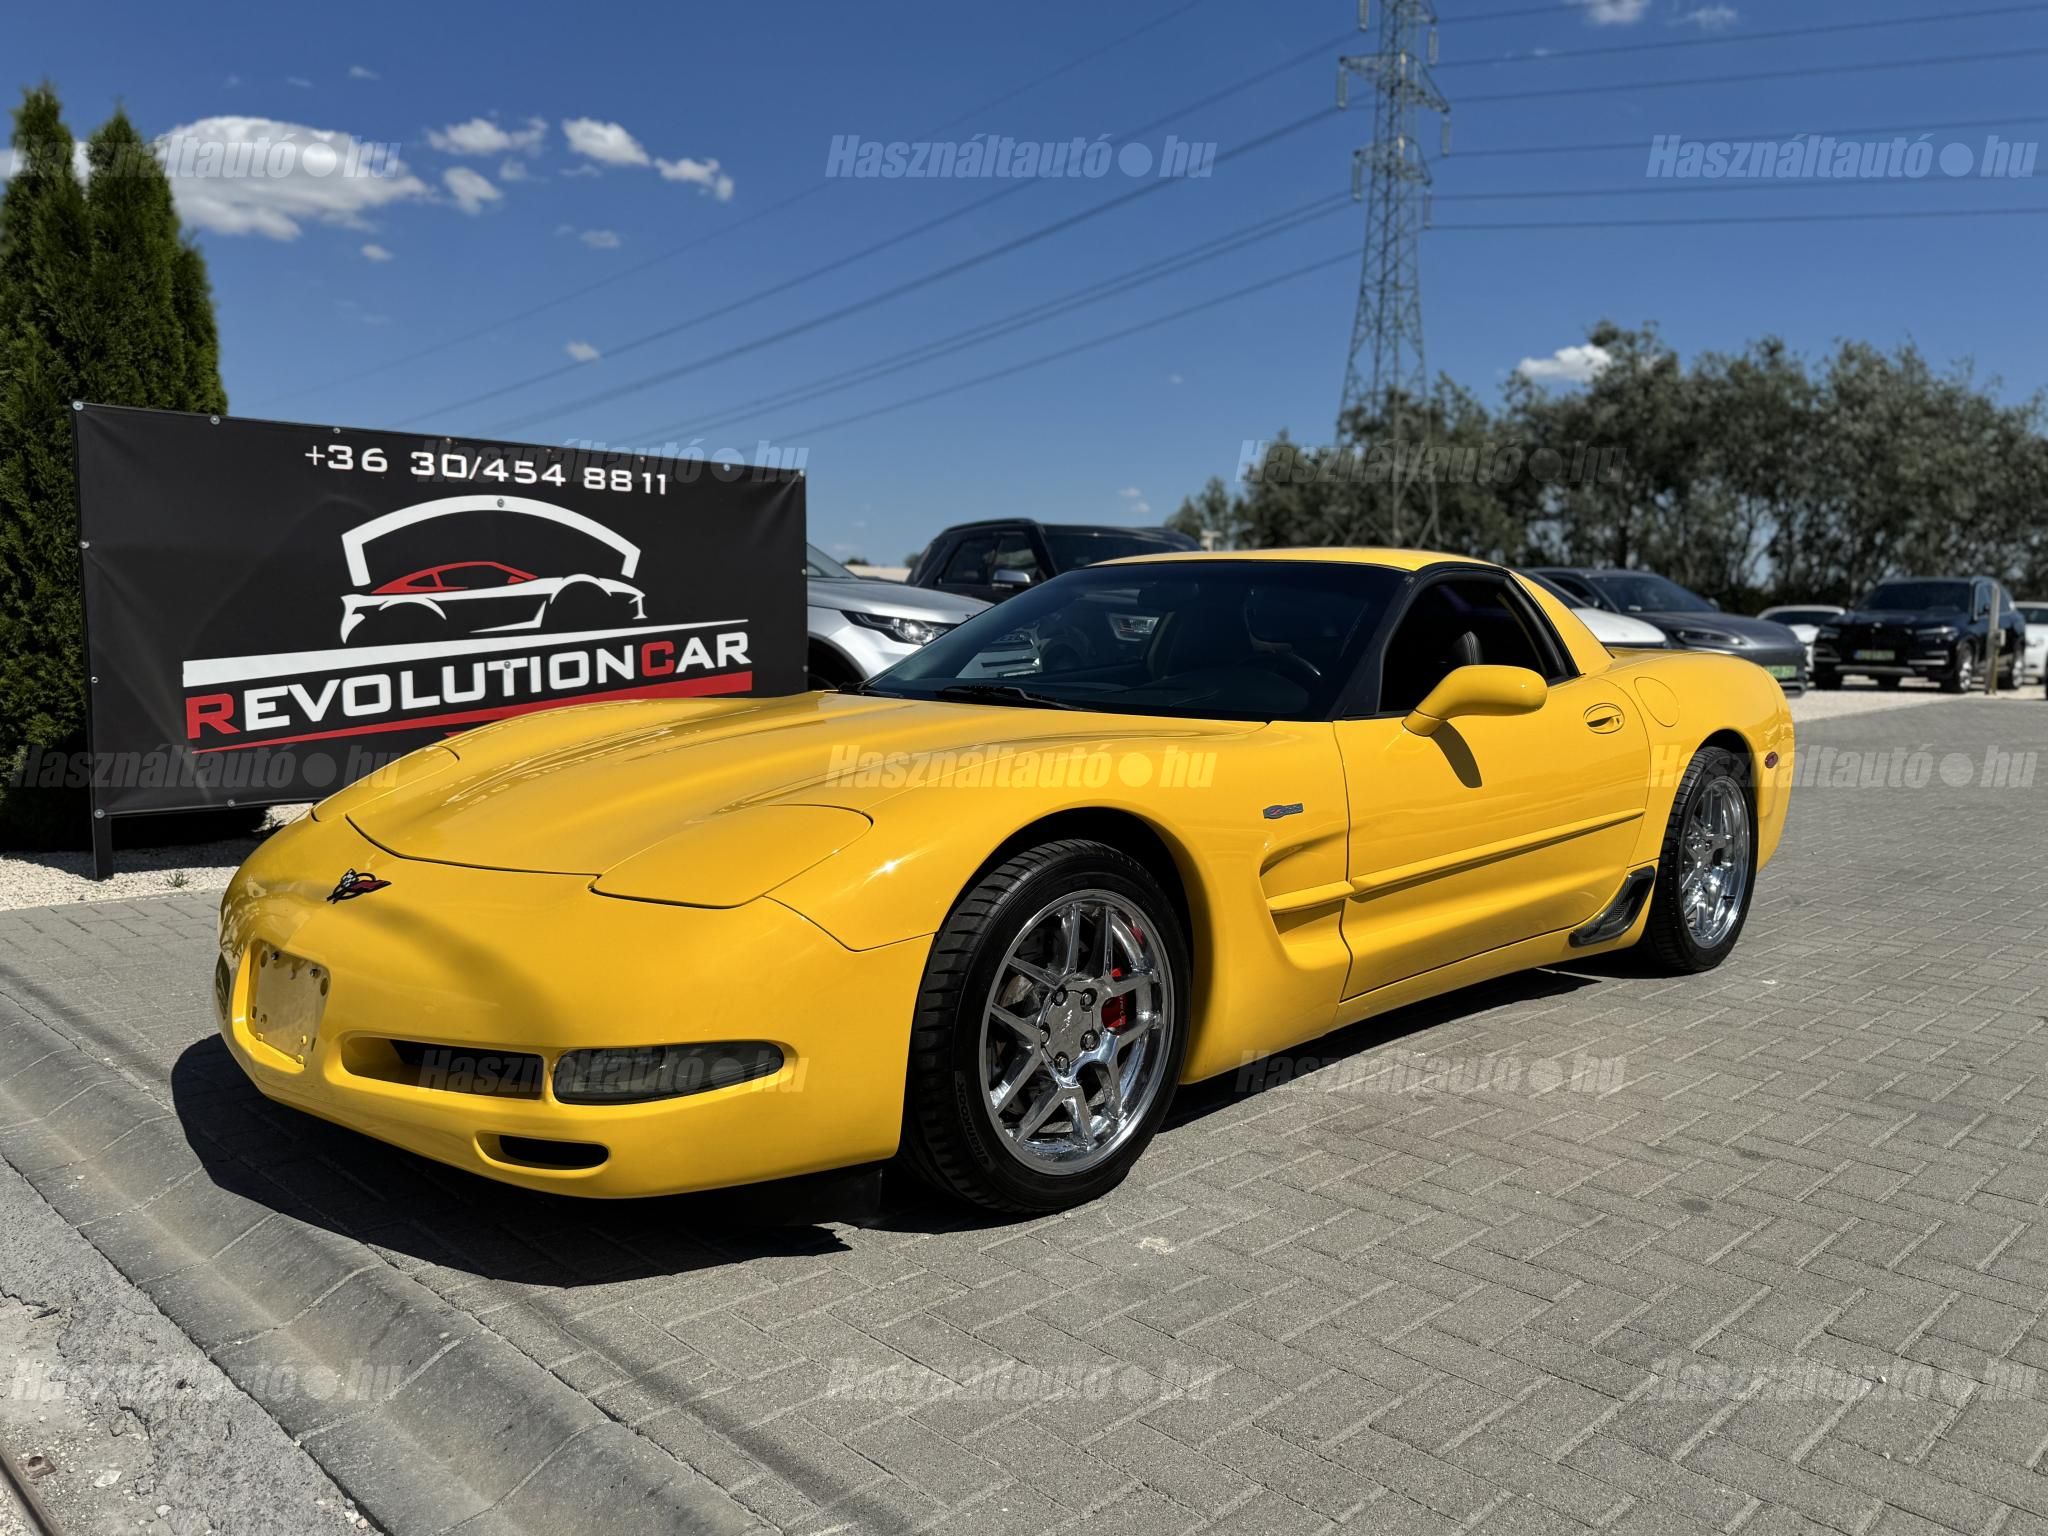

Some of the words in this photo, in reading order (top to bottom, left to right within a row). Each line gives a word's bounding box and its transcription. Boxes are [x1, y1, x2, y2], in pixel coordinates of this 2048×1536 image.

[304, 445, 388, 473] +36
[410, 451, 566, 488] 30/454
[583, 466, 667, 495] 8811
